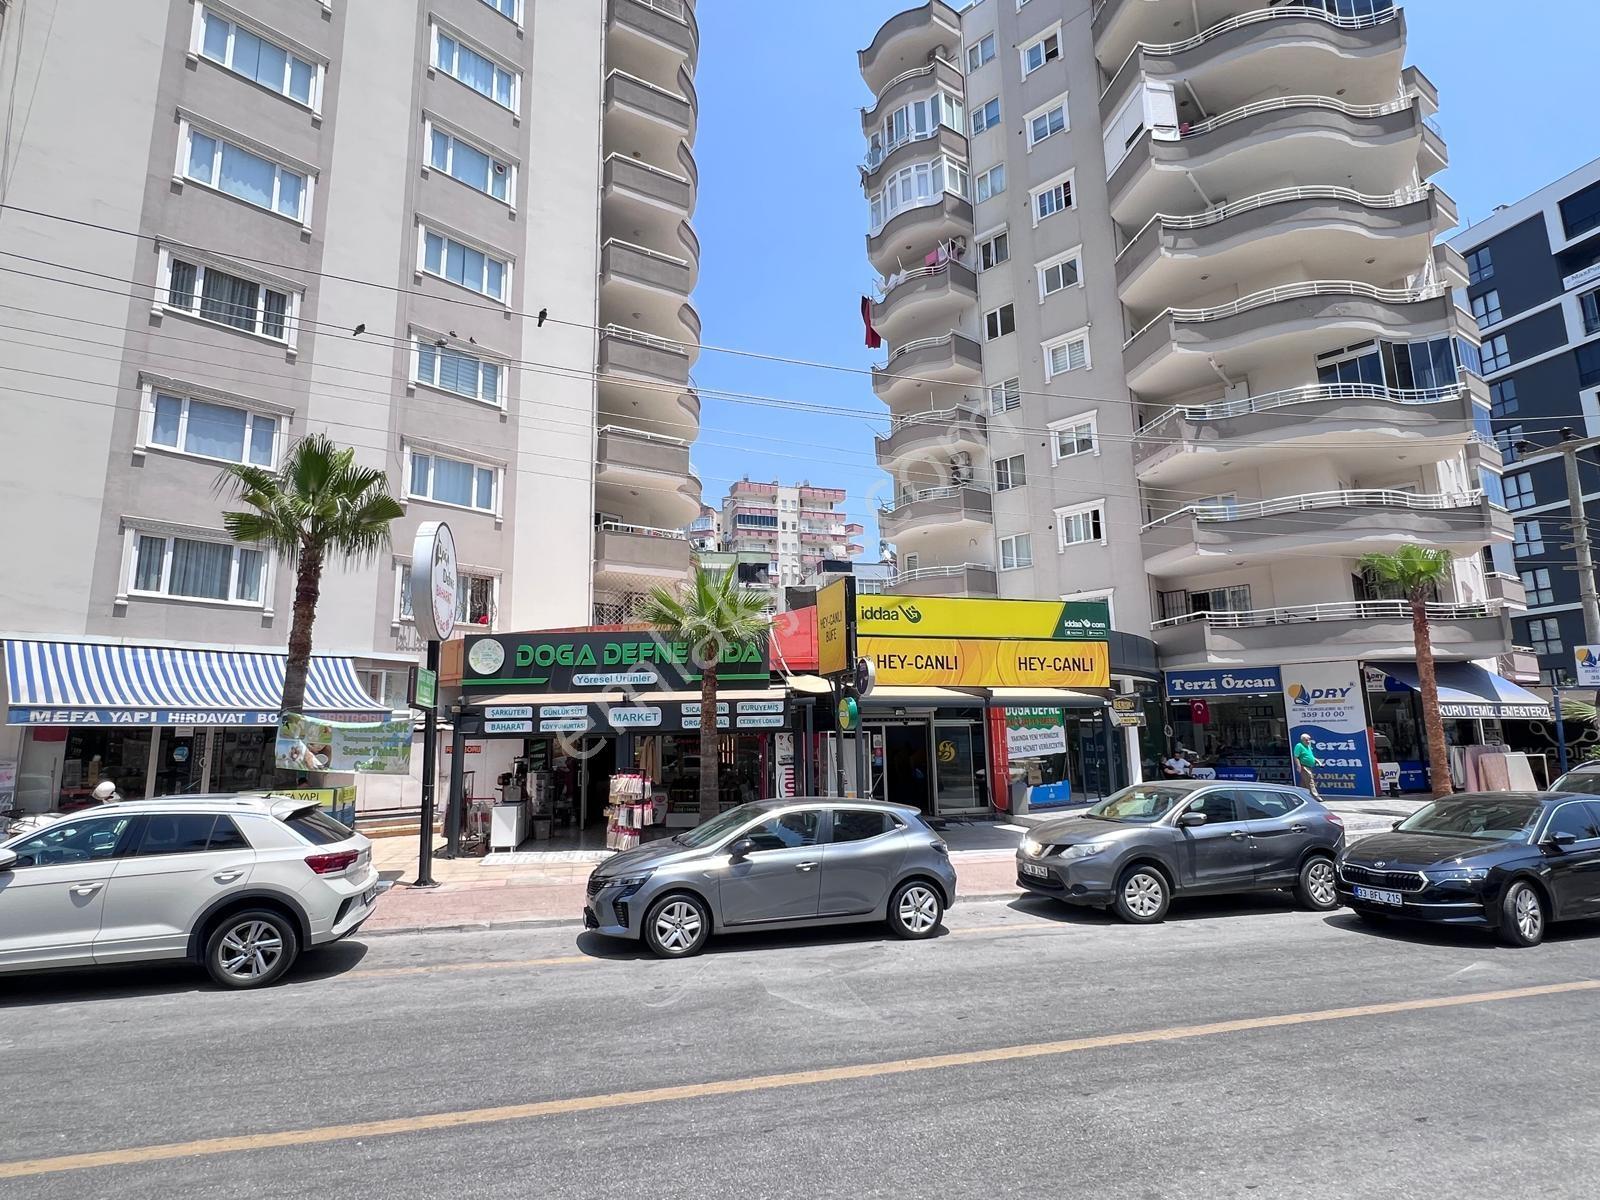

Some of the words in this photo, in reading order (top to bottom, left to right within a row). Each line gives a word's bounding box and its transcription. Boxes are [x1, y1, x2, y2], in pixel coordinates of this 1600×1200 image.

[861, 606, 899, 621] iddaa
[820, 611, 842, 630] HEY-CANLI
[1064, 620, 1083, 629] iddaa
[516, 644, 597, 667] DOGA
[604, 642, 689, 664] DEFNE
[697, 641, 763, 663] IDA
[877, 654, 958, 670] HEY-CANLI
[1018, 657, 1094, 671] HEY-CANLI
[577, 676, 613, 684] Yöresel
[1172, 678, 1217, 690] Terzi
[1221, 674, 1276, 689] Özcan
[1311, 687, 1351, 699] DRY
[543, 708, 570, 716] GÜNLÜK
[570, 707, 584, 715] SÜT
[1032, 707, 1060, 715] DEFNE
[1301, 711, 1318, 719] 359
[1321, 711, 1331, 719] 10
[1439, 704, 1467, 717] KURU
[29, 711, 100, 723] MEFA
[109, 711, 157, 723] YAPI
[613, 713, 659, 723] MARKET
[684, 719, 702, 727] ORGA
[716, 718, 727, 726] AL
[491, 723, 526, 731] BAHARAT
[1316, 757, 1362, 767] zcan
[299, 792, 319, 801] YAPI
[1358, 888, 1367, 898] 33
[1386, 892, 1401, 904] 215
